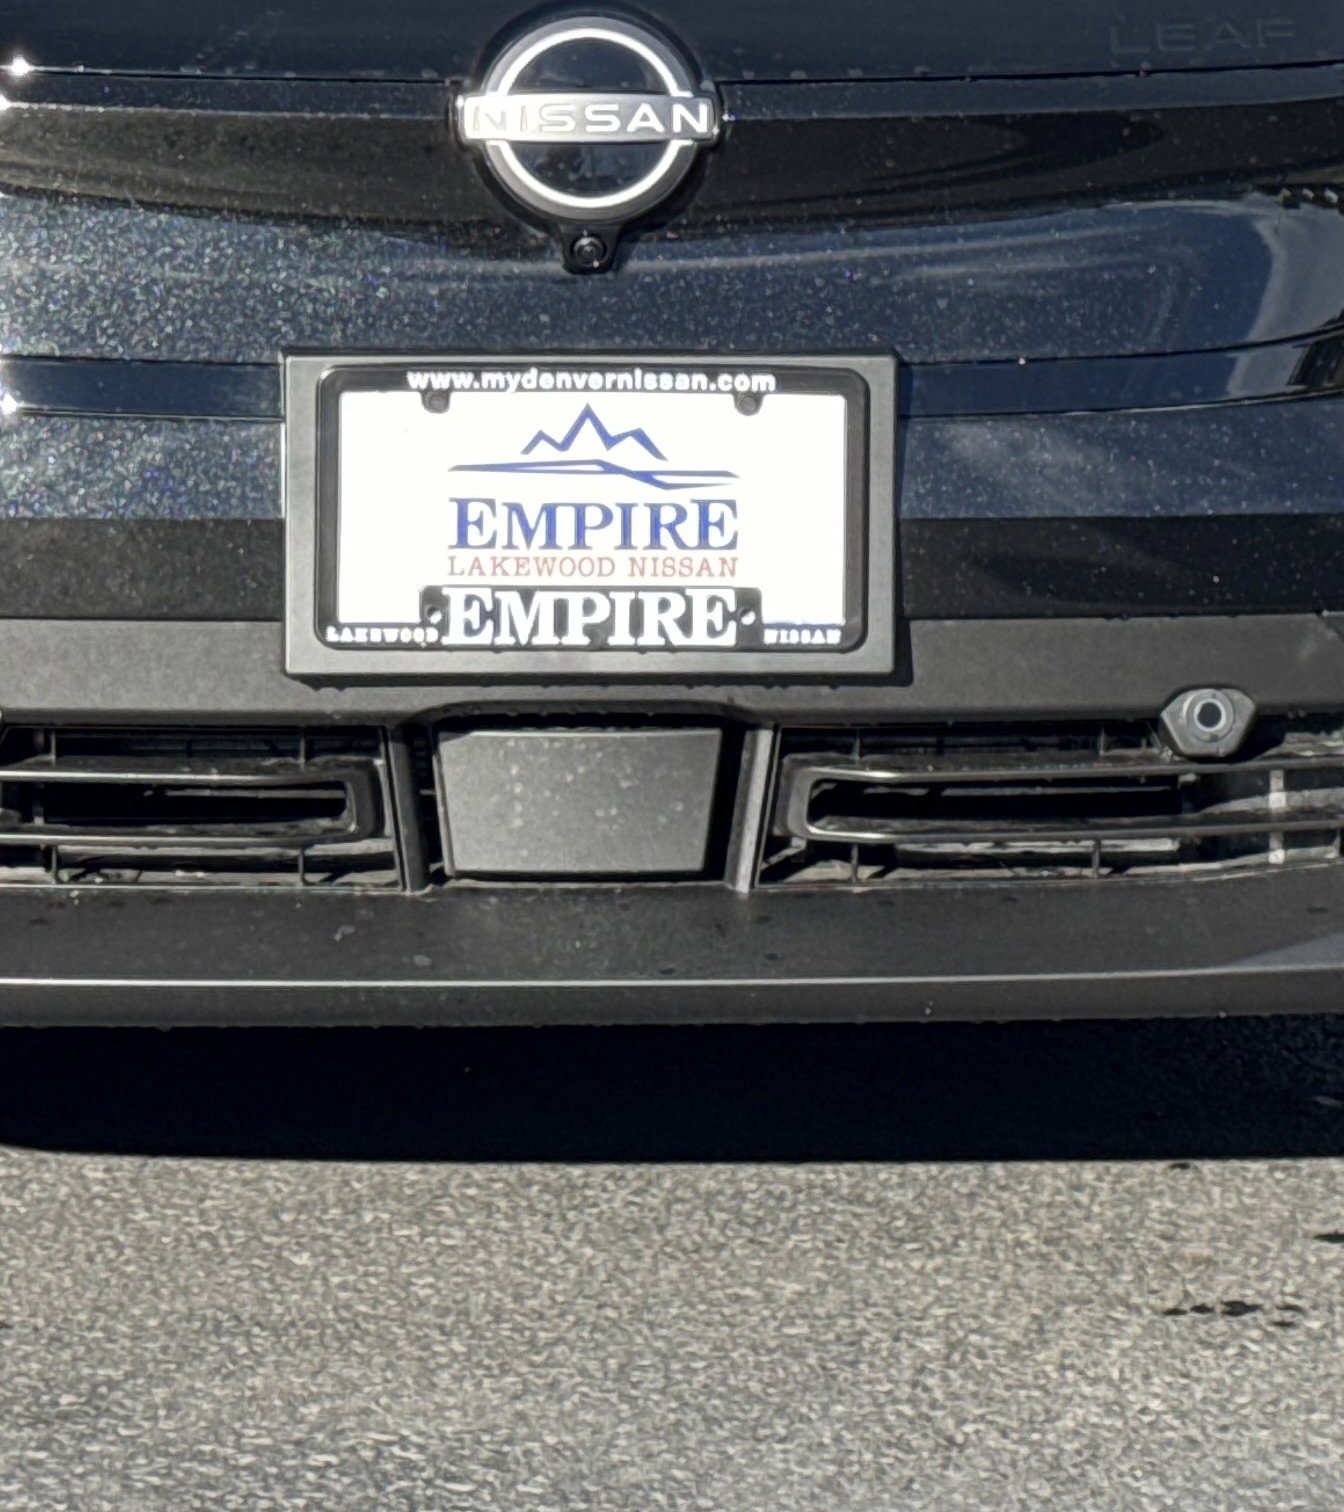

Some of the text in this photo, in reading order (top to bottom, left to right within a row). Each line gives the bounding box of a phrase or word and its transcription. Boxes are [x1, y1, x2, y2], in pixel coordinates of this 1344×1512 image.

[1109, 17, 1295, 54] LEAF
[471, 100, 709, 134] NISSAN
[407, 367, 776, 393] www.mydenvernissan.com
[448, 498, 739, 550] EMPIRE
[447, 556, 738, 577] LAKEWOOD NISSAN
[441, 587, 737, 647] EMPIRE
